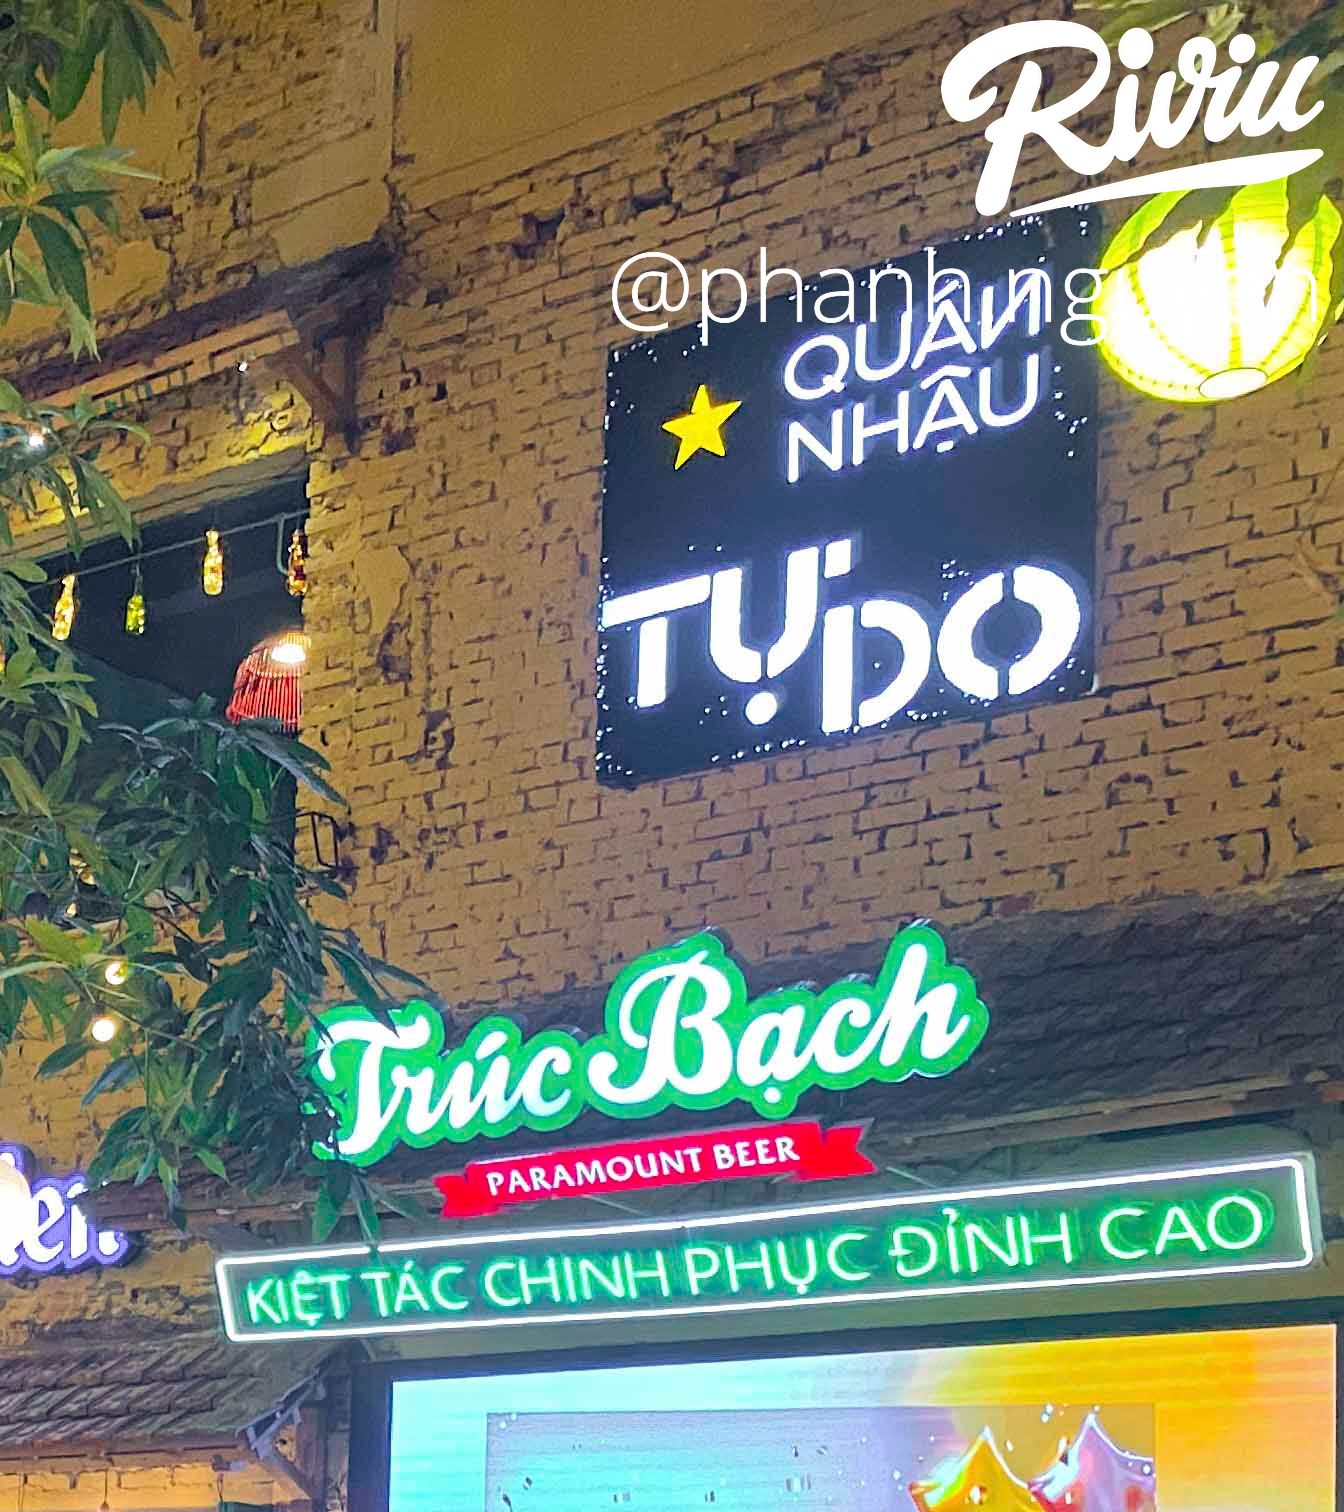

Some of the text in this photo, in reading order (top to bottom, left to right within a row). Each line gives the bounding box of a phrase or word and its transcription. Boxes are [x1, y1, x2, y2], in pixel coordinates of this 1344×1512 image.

[787, 352, 1040, 484] NHẬU
[313, 940, 965, 1155] Trúc Bạch
[485, 1136, 800, 1198] PARAMOUNT BEER
[247, 1192, 1266, 1326] KIỆT TÁC CHINH PHỤC ĐỈNH CAO
